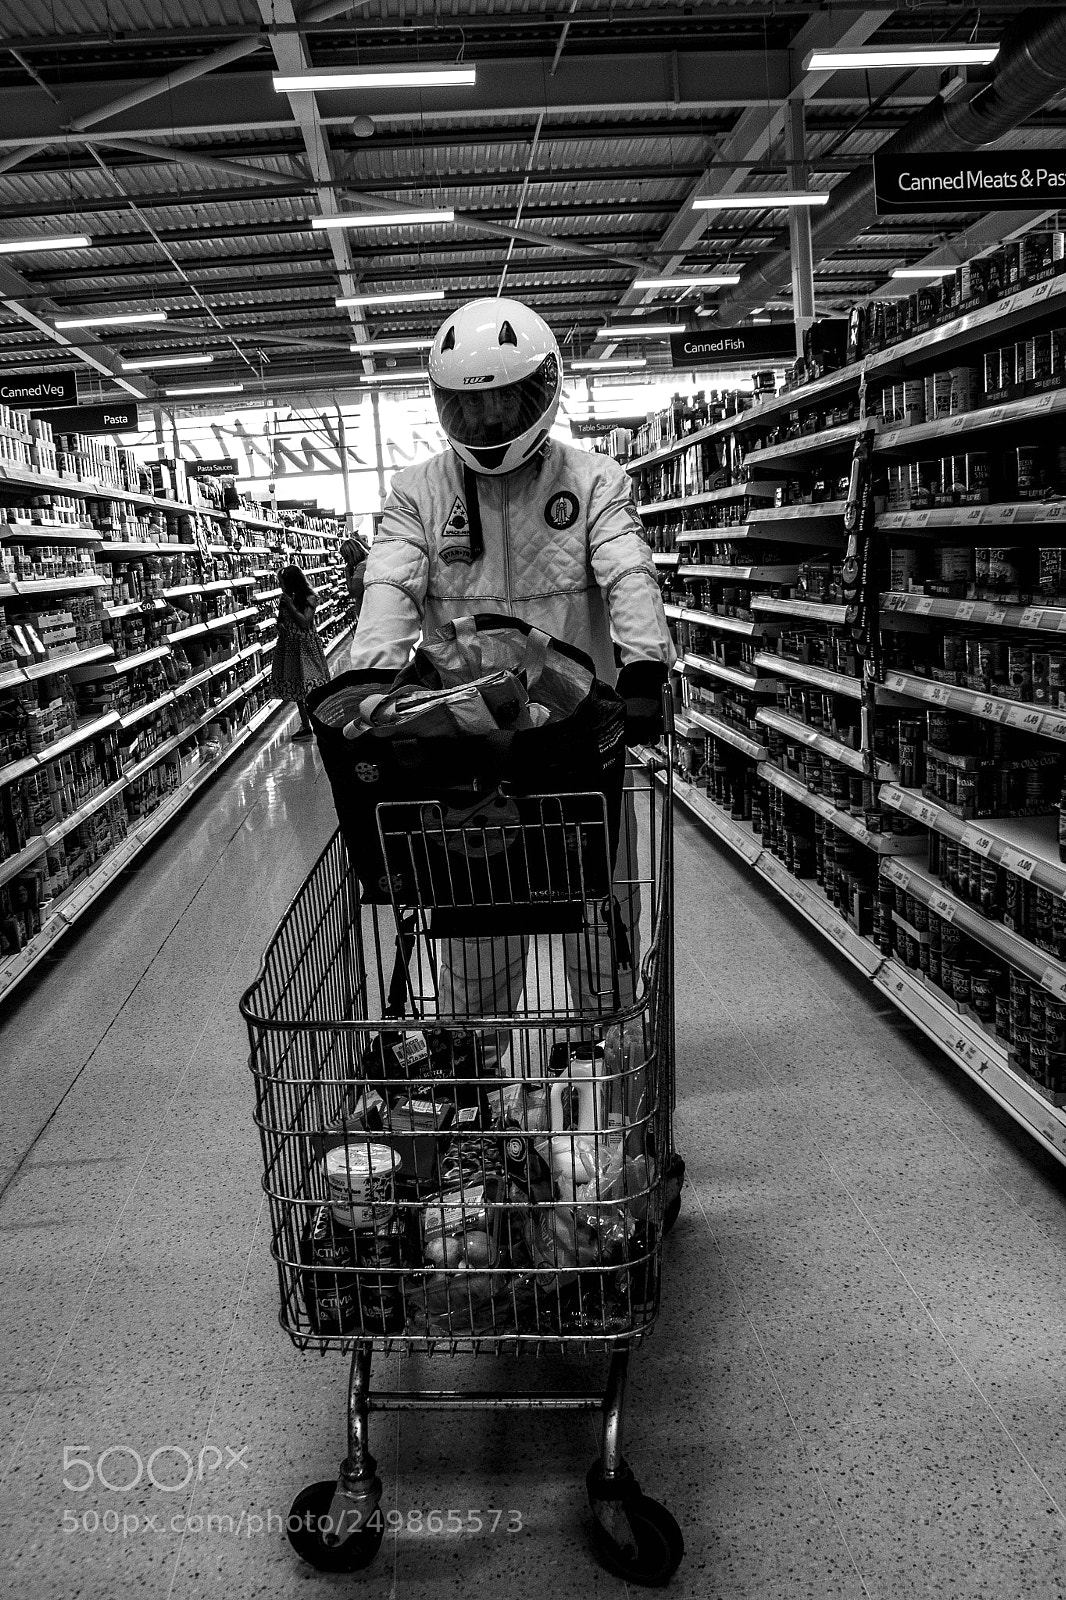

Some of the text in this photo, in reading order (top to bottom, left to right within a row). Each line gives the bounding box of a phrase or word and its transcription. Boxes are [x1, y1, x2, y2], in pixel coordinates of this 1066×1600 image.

[898, 168, 1066, 191] Canned Meats & Pas
[683, 338, 745, 353] Canned Fish
[0, 383, 64, 398] Canned Veg
[103, 415, 128, 425] Pasta
[578, 423, 619, 432] Table Sauces
